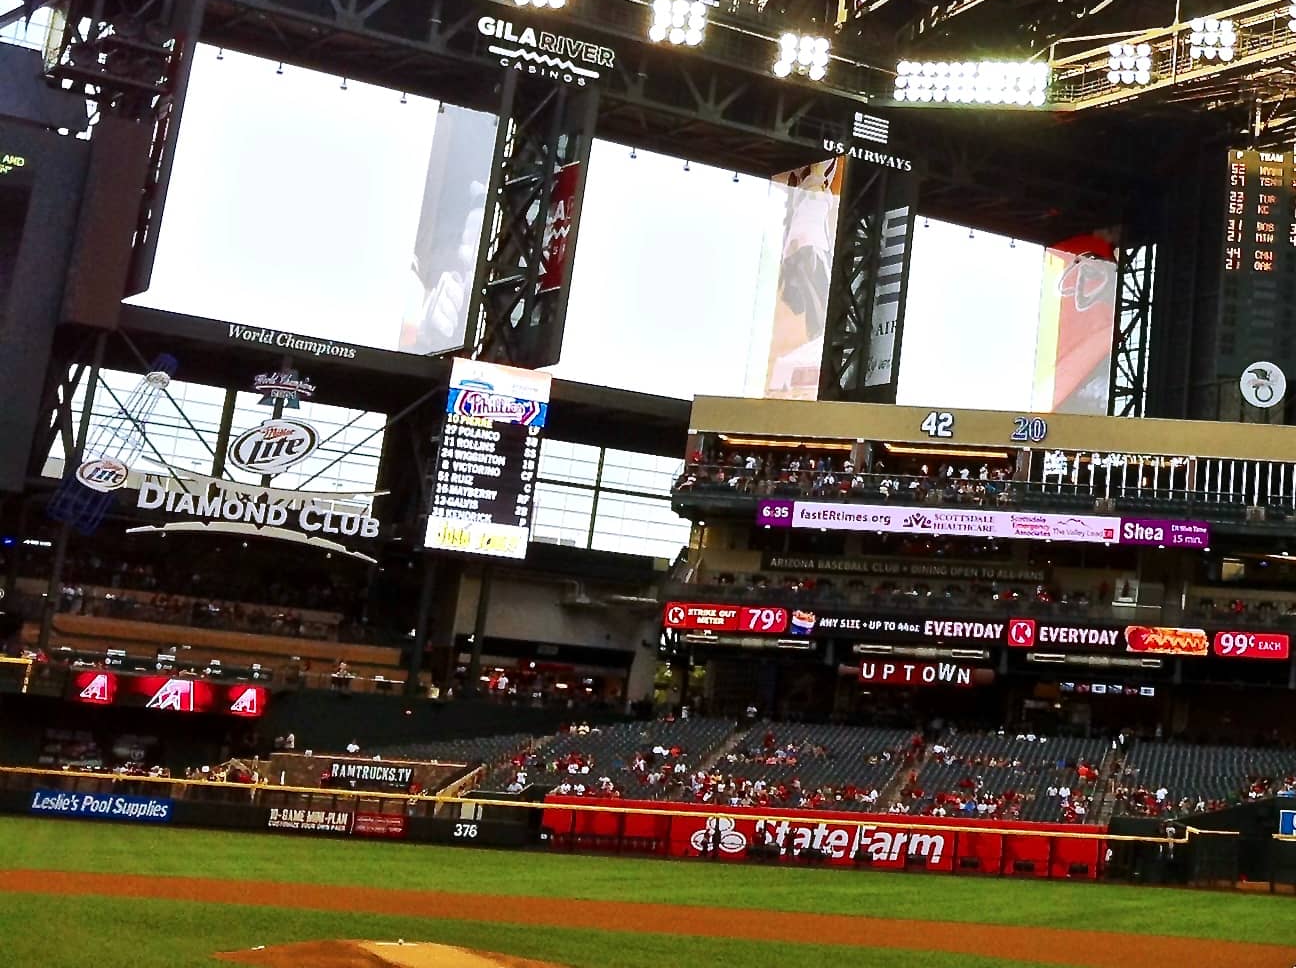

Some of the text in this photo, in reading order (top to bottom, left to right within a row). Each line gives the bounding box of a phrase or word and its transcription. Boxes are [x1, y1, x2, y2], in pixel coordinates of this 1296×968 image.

[478, 17, 616, 68] GILA RIVER
[500, 58, 586, 87] CASINOS
[848, 146, 912, 172] AIRWAYS
[1259, 152, 1284, 164] TEAM
[1257, 204, 1271, 215] KC
[228, 323, 357, 360] World Champions
[468, 392, 527, 416] Phillies
[920, 411, 954, 438] 42
[1010, 417, 1047, 442] 20
[457, 426, 501, 442] POLANCO
[245, 437, 305, 465] Lite
[456, 438, 497, 453] ROLLINS
[454, 449, 507, 467] WIGGINTON
[452, 461, 502, 478] VICTORINO
[450, 472, 475, 487] RUIZ
[449, 484, 498, 501] MAYBERRY
[137, 482, 380, 538] DIAMOND CLUB
[445, 508, 493, 523] KENDRICK
[761, 506, 789, 518] 6:35
[934, 513, 994, 523] SCOTTSDALE
[933, 522, 993, 532] HEALTHCARE
[1066, 528, 1085, 538] Valley
[1123, 522, 1164, 541] Shea
[1193, 525, 1207, 534] Time
[1172, 534, 1184, 544] 15
[770, 557, 815, 569] ARIZONA
[817, 559, 869, 572] BASEBALL
[871, 562, 900, 573] CLUB
[910, 564, 947, 576] DINING
[950, 566, 978, 577] OPEN
[982, 567, 994, 578] TO
[687, 608, 736, 618] STRIKE OUT
[696, 616, 725, 625] METER
[748, 609, 783, 630] 79¢
[819, 617, 838, 628] ANY
[839, 619, 861, 629] SIZE
[868, 620, 883, 631] UP
[883, 621, 897, 631] TO
[924, 620, 1119, 646] EVERYDAY EVERYDAY
[1218, 632, 1281, 654] 99¢ EACH
[861, 663, 970, 685] UPTOWN
[331, 763, 412, 782] RAMTRUCKS.TV
[31, 791, 168, 818] Leslie's Pool Supplies
[270, 809, 306, 822] 10-GAME
[306, 810, 349, 825] MINI-PLAN
[453, 823, 478, 838] 376
[755, 818, 945, 864] State Farm
